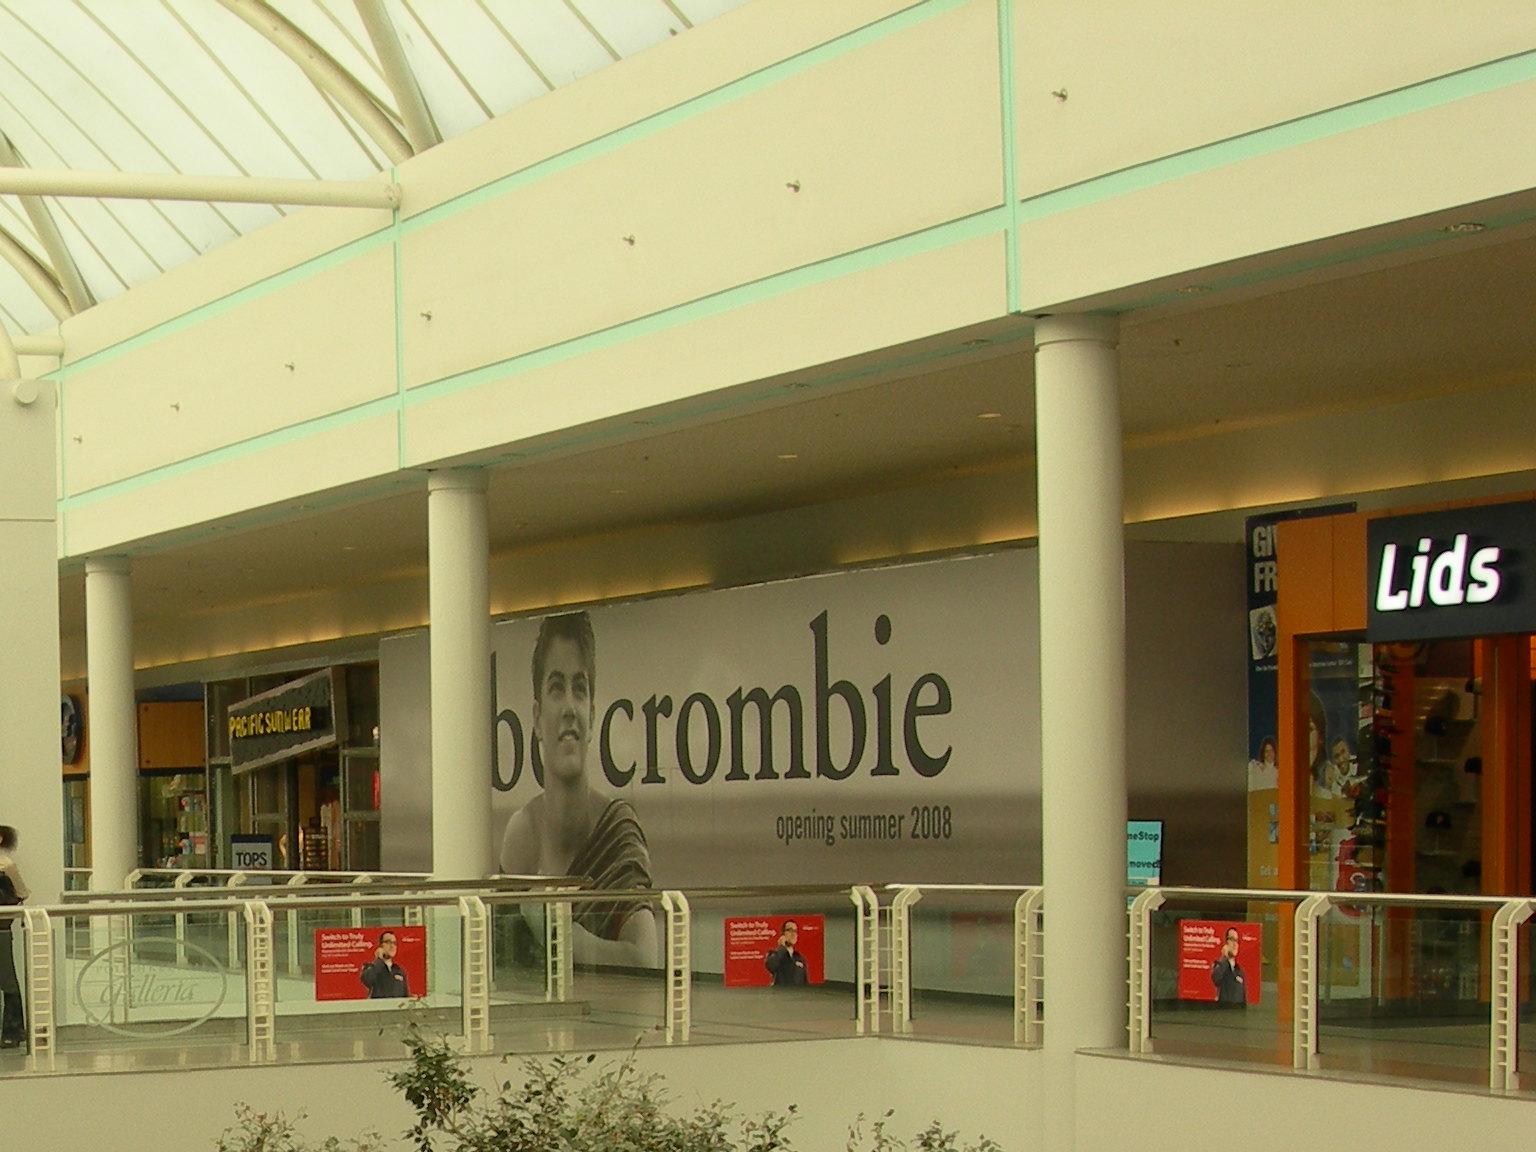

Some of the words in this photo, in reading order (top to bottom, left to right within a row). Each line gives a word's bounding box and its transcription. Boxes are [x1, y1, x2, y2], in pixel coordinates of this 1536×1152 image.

[1374, 533, 1502, 612] Lids
[228, 712, 265, 739] PACIFIC
[776, 808, 835, 846] opening
[840, 813, 905, 840] summer
[911, 805, 952, 840] 2008
[235, 851, 268, 868] TOPS
